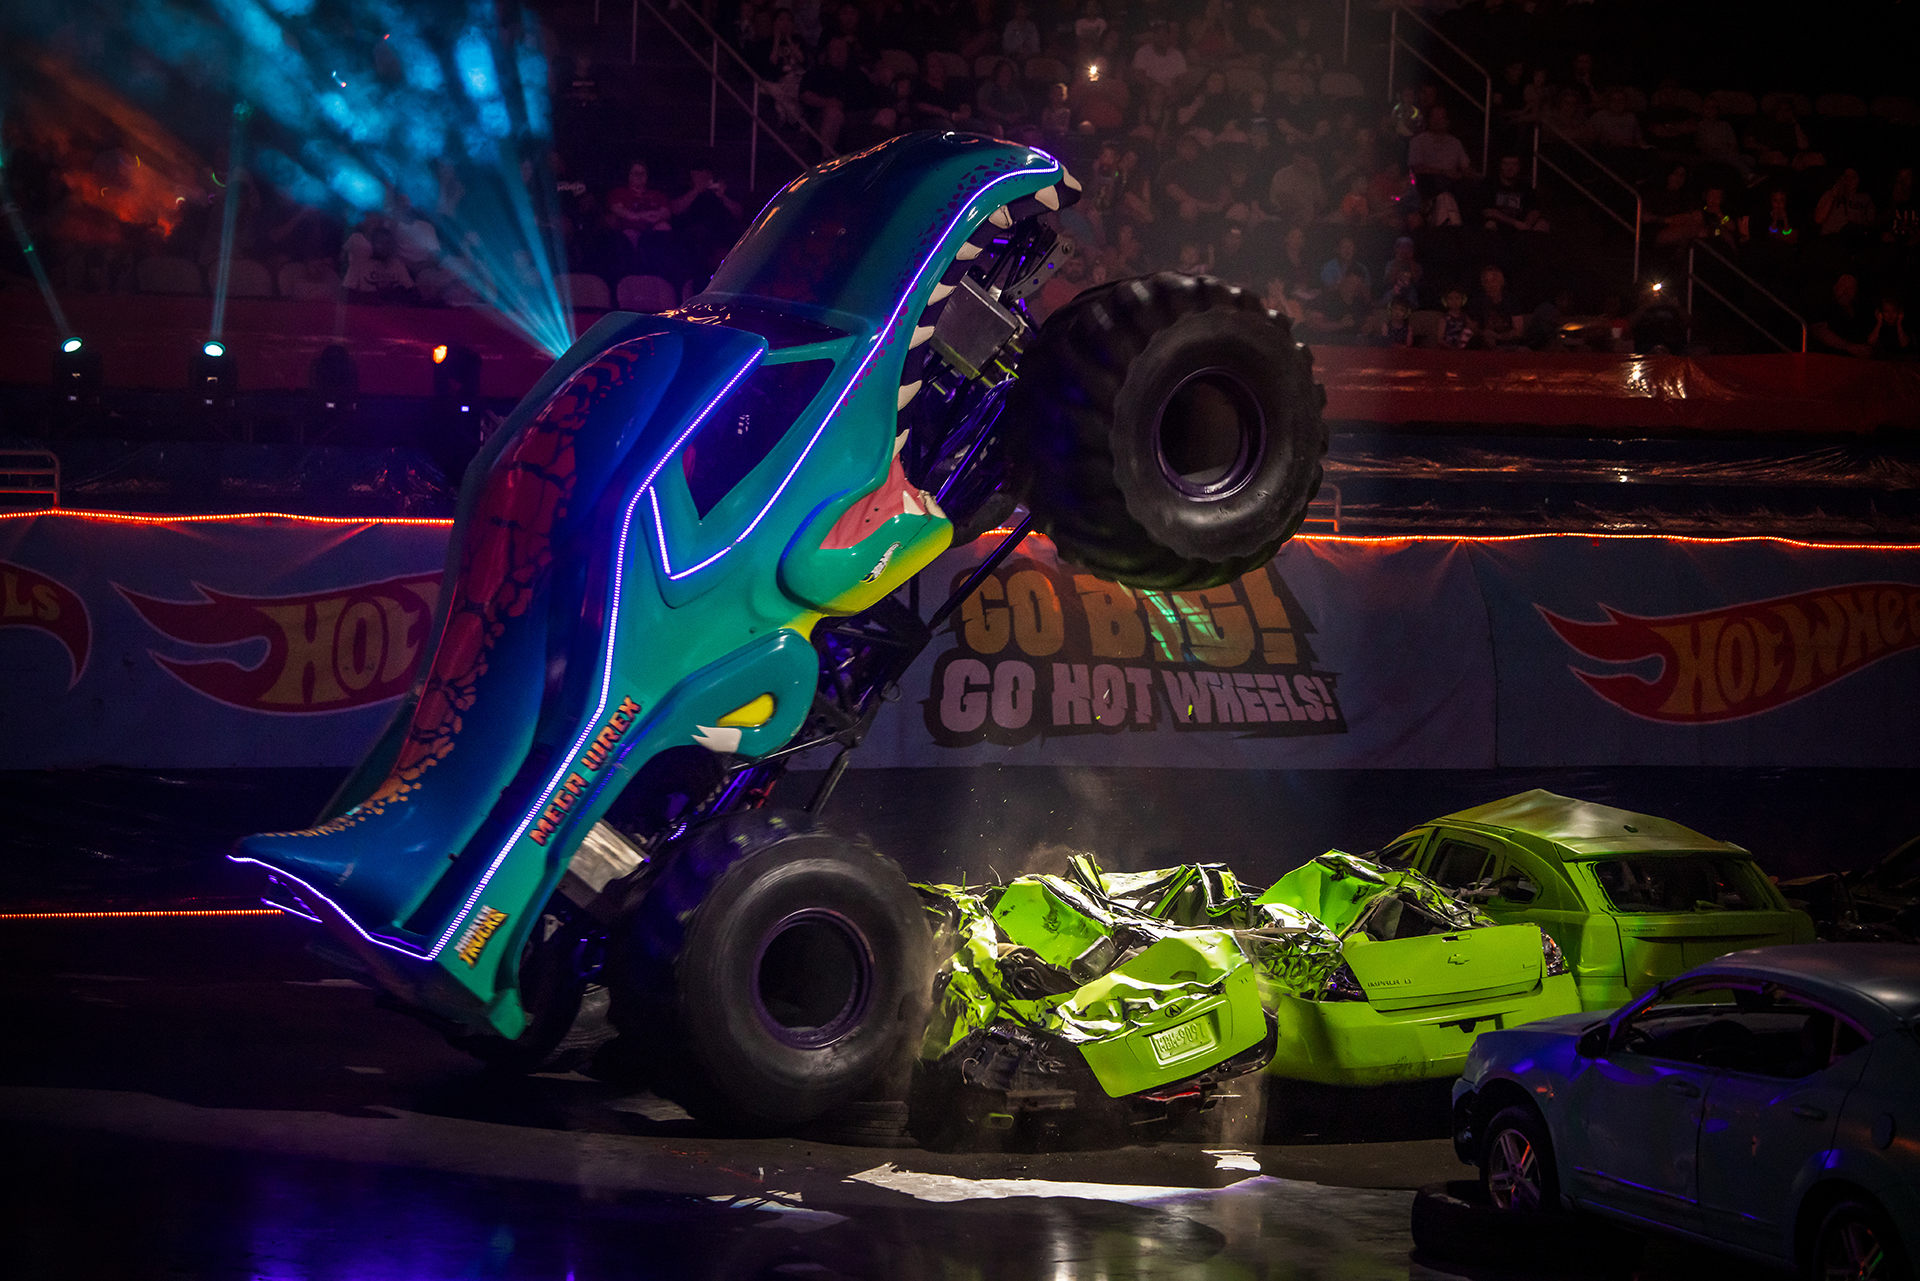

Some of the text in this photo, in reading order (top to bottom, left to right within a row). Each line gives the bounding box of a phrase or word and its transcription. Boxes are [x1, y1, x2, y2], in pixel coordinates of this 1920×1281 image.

[253, 596, 421, 705] HOT
[959, 567, 1299, 667] GO BIG!
[1649, 616, 1784, 715] HOT
[940, 658, 1338, 732] GO HOT WHEELS!
[529, 694, 643, 847] MEGA WREX
